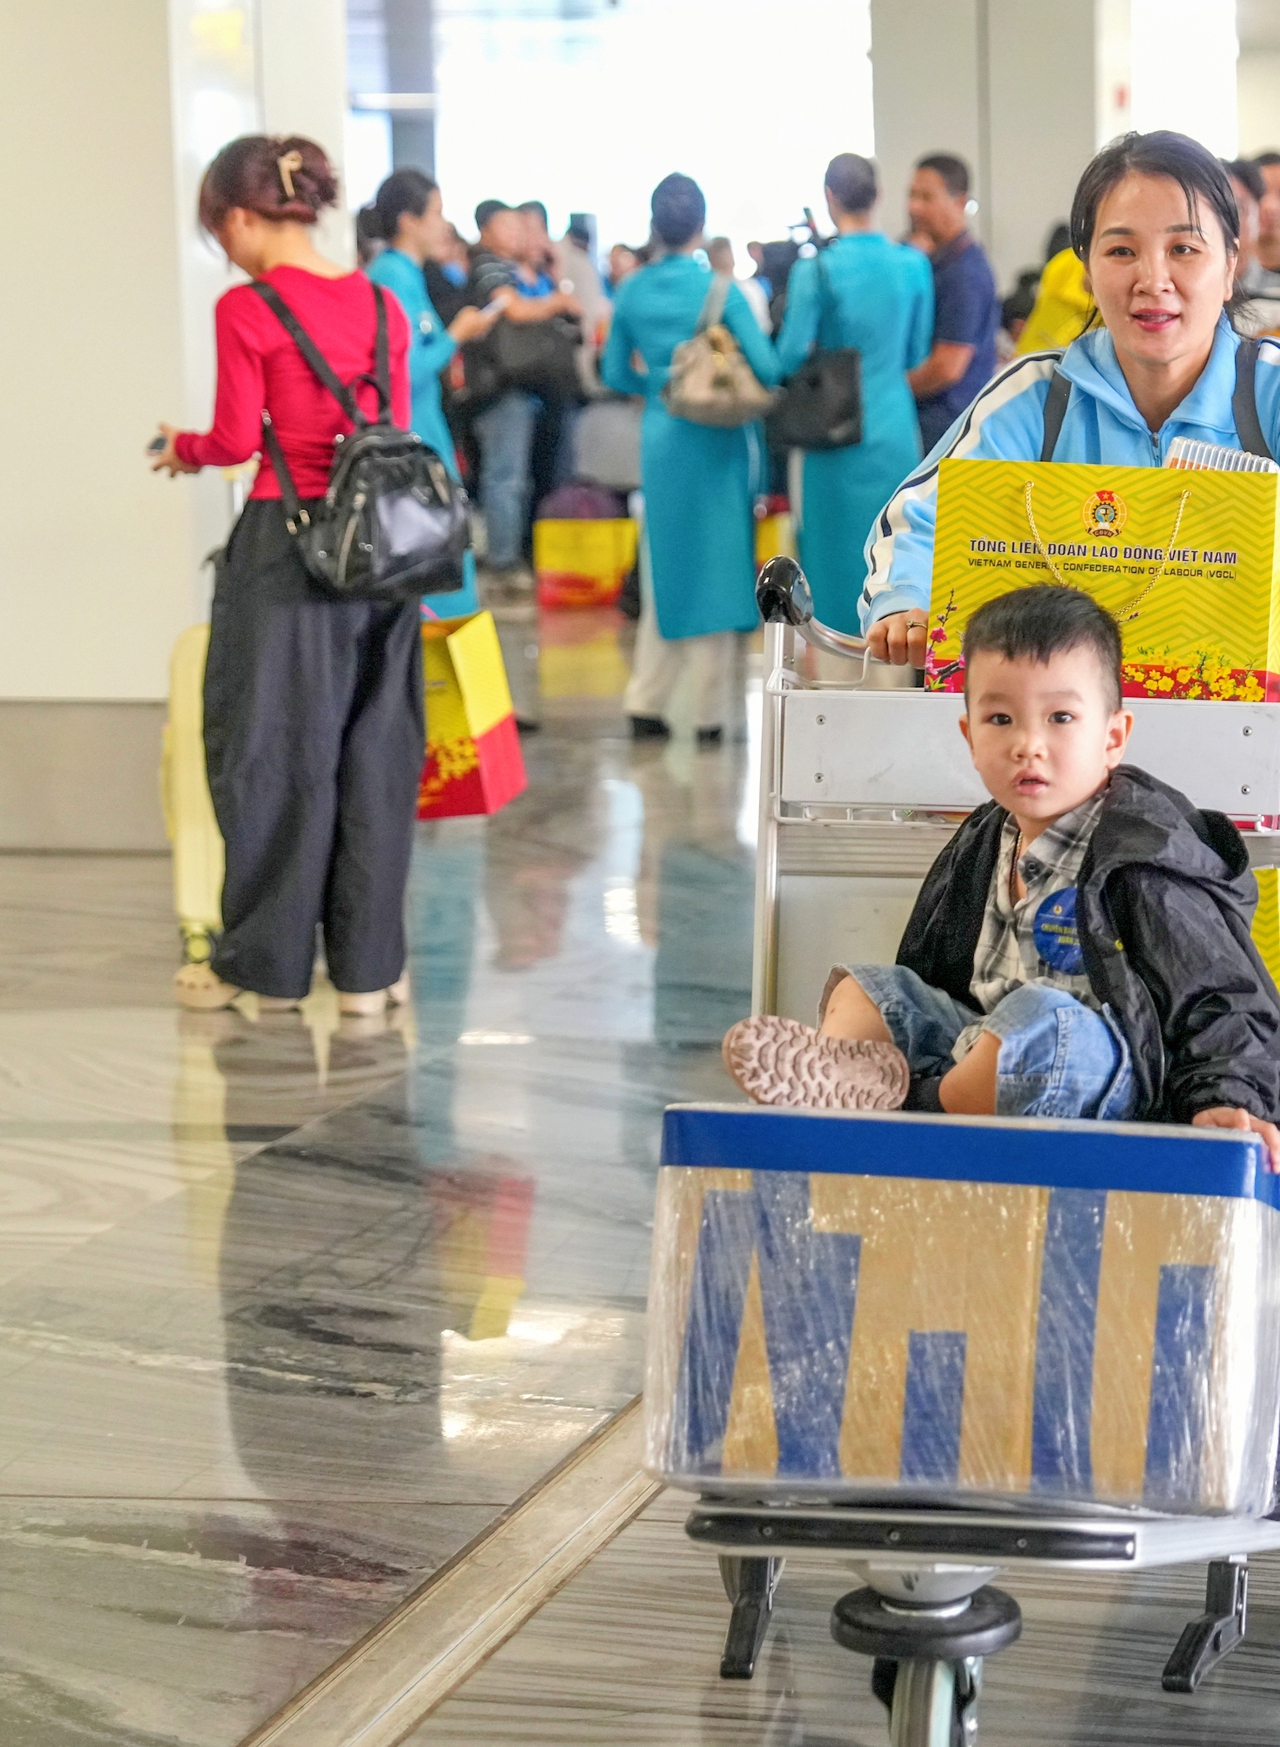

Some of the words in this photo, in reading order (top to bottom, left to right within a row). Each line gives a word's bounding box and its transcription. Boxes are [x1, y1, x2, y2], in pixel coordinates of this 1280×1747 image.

[1047, 541, 1087, 557] ĐOÀN
[1092, 545, 1118, 558] LAO
[1123, 545, 1163, 562] ĐỘNG
[1168, 547, 1198, 564] VIỆT
[1203, 551, 1237, 564] NAM
[968, 558, 1012, 568] VIETNAM
[1014, 560, 1060, 570] GENERL
[1063, 562, 1145, 575] CONFEDERATION
[1163, 567, 1203, 577] LABOUR
[1206, 569, 1237, 580] (VGCL)
